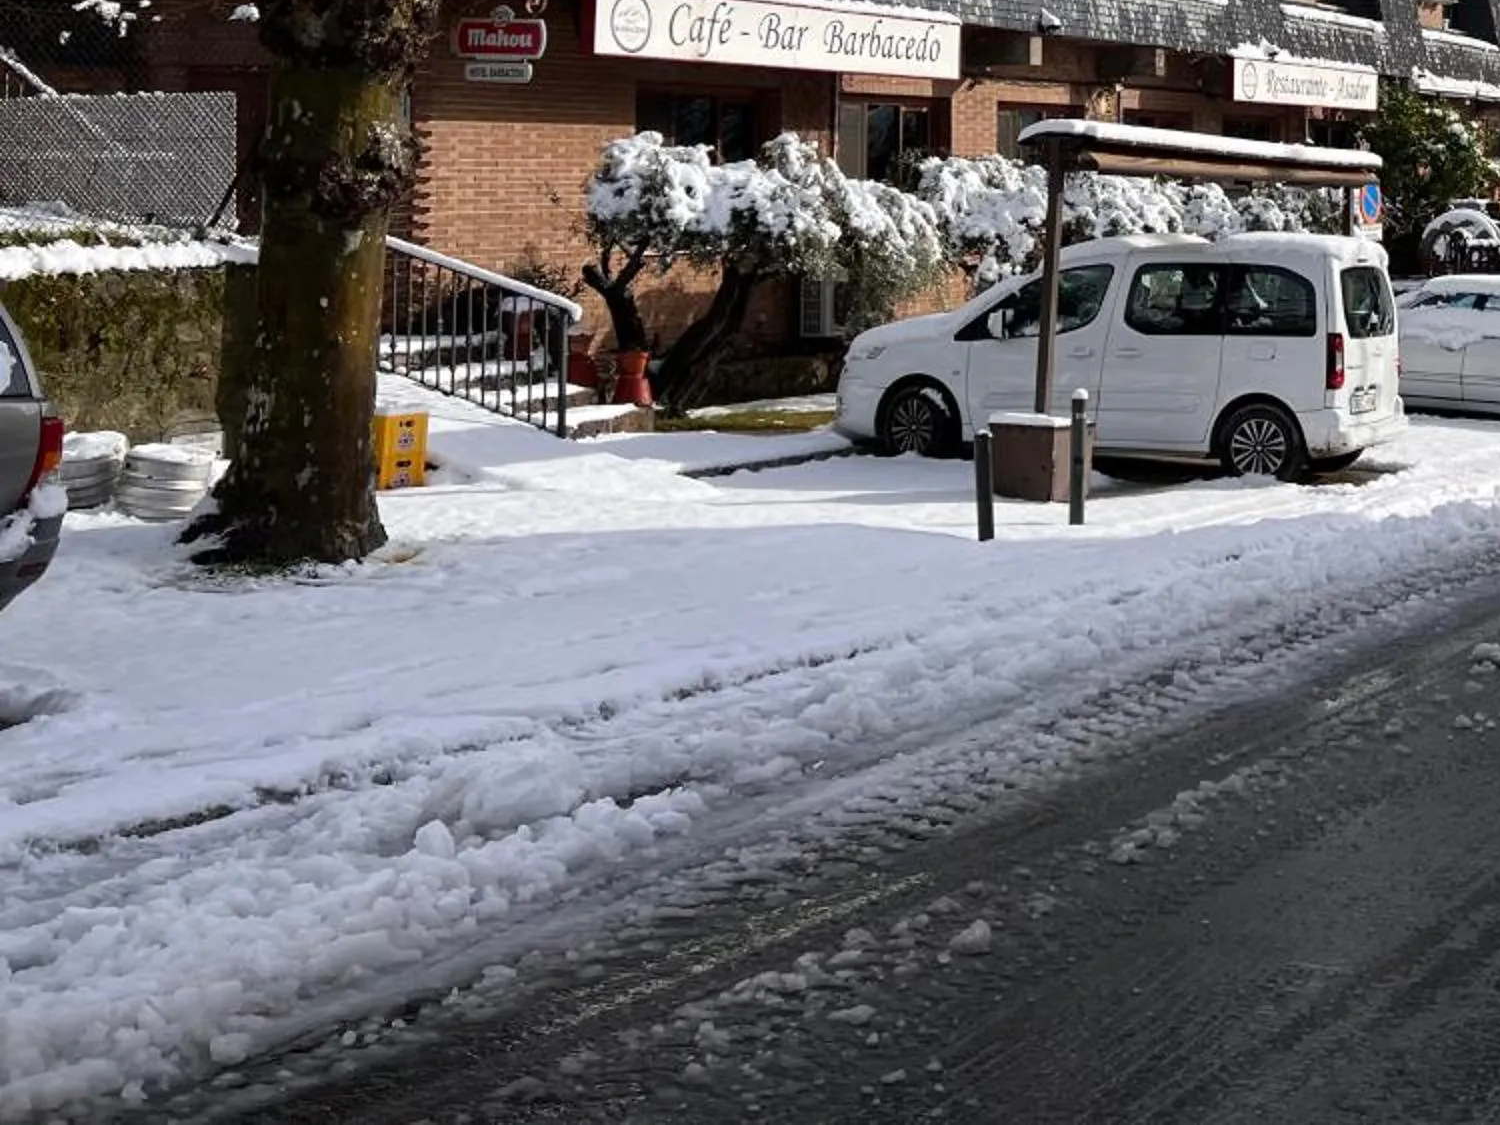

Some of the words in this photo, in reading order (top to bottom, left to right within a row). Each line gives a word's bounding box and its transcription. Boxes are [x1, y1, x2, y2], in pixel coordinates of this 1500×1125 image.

[467, 28, 533, 47] Mahou
[669, 2, 733, 57] Café
[758, 13, 809, 51] Bar
[823, 19, 941, 63] Barbacedo
[1266, 69, 1328, 98] Restaurante
